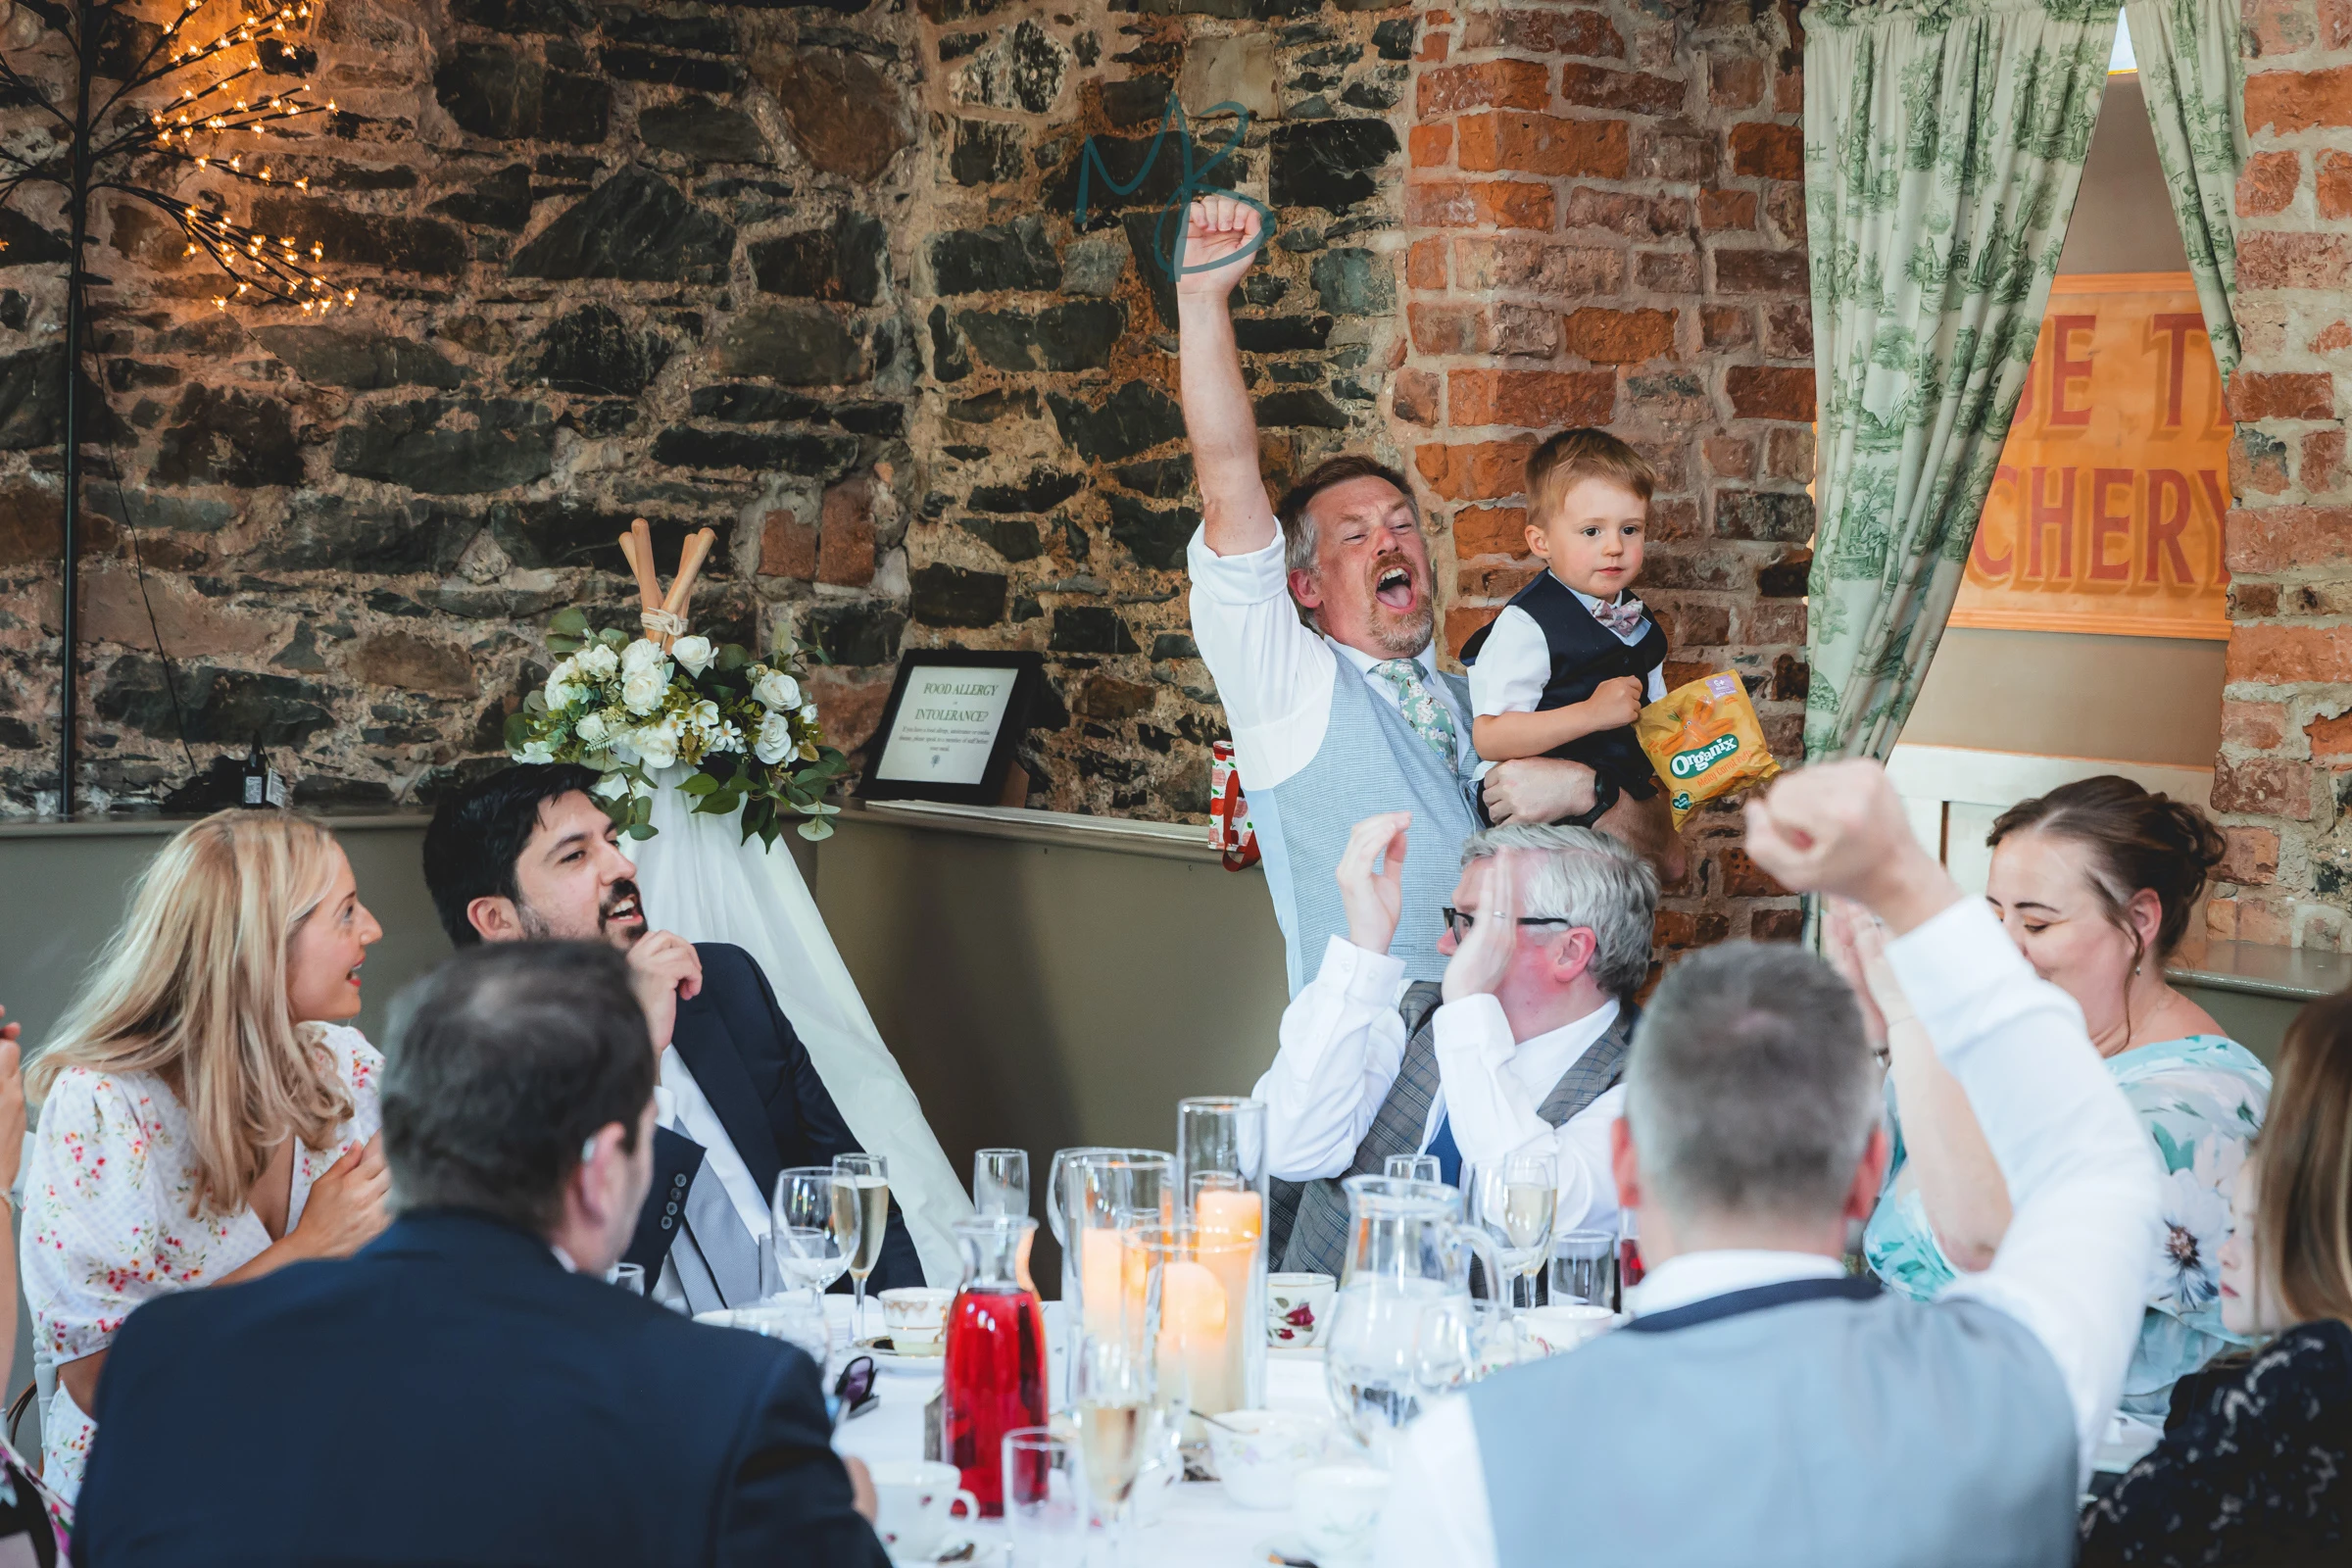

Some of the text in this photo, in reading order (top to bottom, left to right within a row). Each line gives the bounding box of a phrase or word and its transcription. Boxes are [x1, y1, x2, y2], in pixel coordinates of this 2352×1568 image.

[2152, 313, 2235, 427] T
[923, 682, 999, 697] FOOD ALLERGY
[914, 709, 989, 722] INTOLERANCE?
[1671, 737, 1738, 776] Organix
[1696, 771, 1718, 788] Melty
[1716, 758, 1738, 776] Carrot
